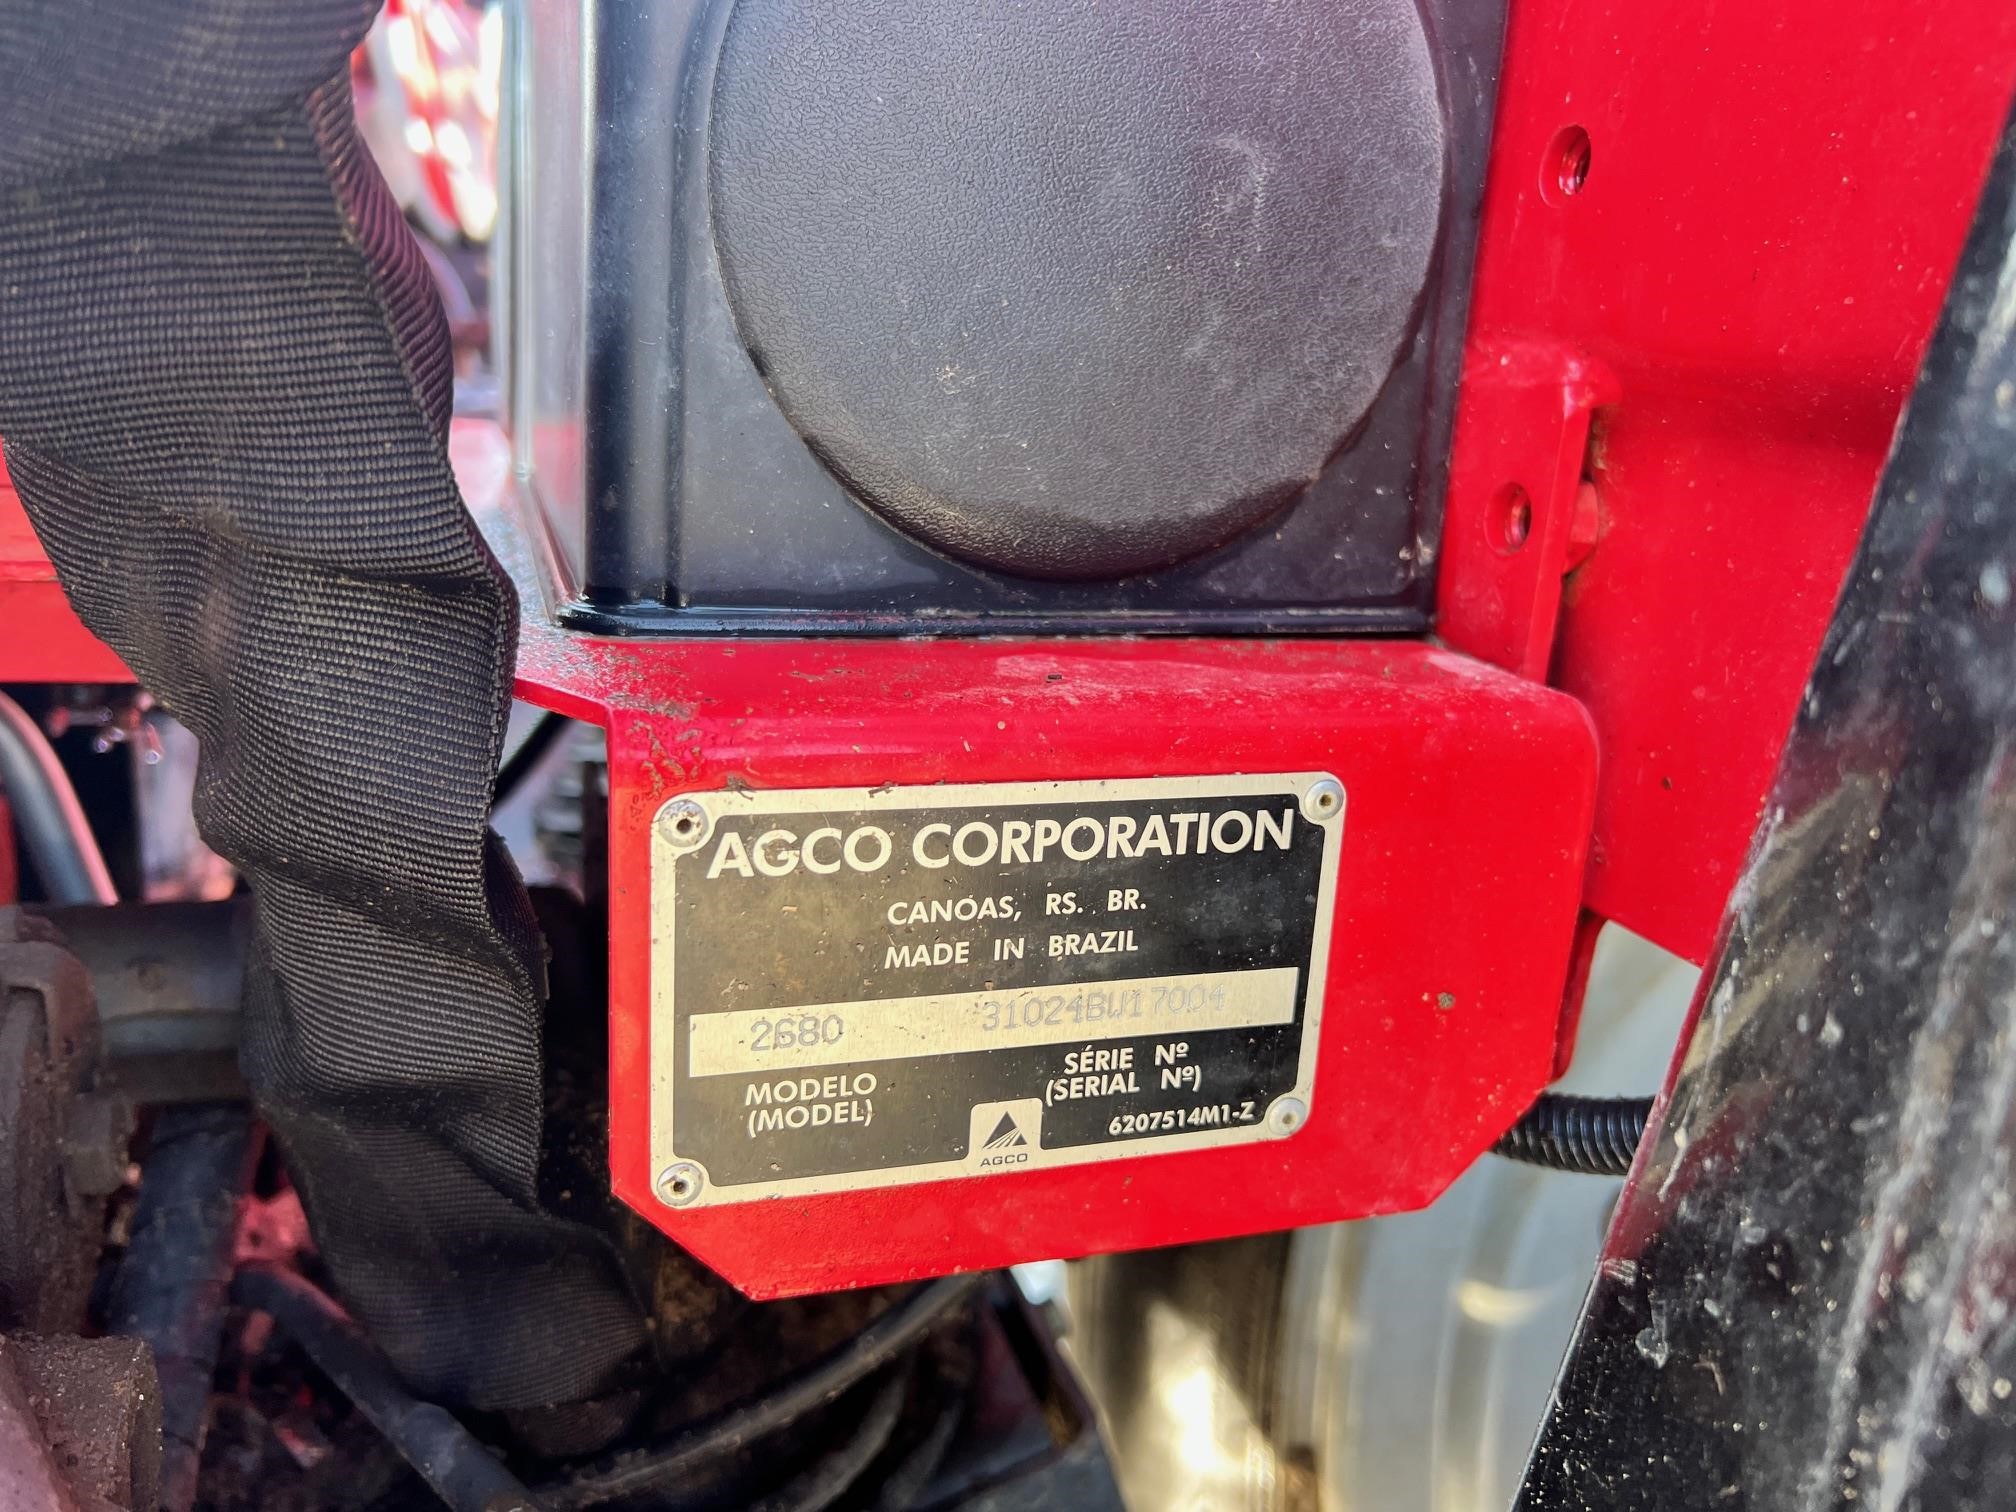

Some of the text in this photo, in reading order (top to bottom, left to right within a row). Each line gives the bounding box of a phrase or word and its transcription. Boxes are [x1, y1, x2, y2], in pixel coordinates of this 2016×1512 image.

[706, 808, 1295, 880] AGCO CORPORATION
[887, 888, 1147, 925] CANOAS, RS. BR.
[884, 930, 1139, 969] MADE IN BRAZIL
[750, 1014, 844, 1052] 2680
[1064, 1044, 1134, 1075] SÉRIE
[745, 1072, 877, 1106] MODELO
[1046, 1071, 1141, 1106] (SERIAL
[748, 1098, 874, 1138] (MODEL)
[1108, 1101, 1256, 1136] 6207514M1-Z
[980, 1153, 1029, 1168] AGCO
